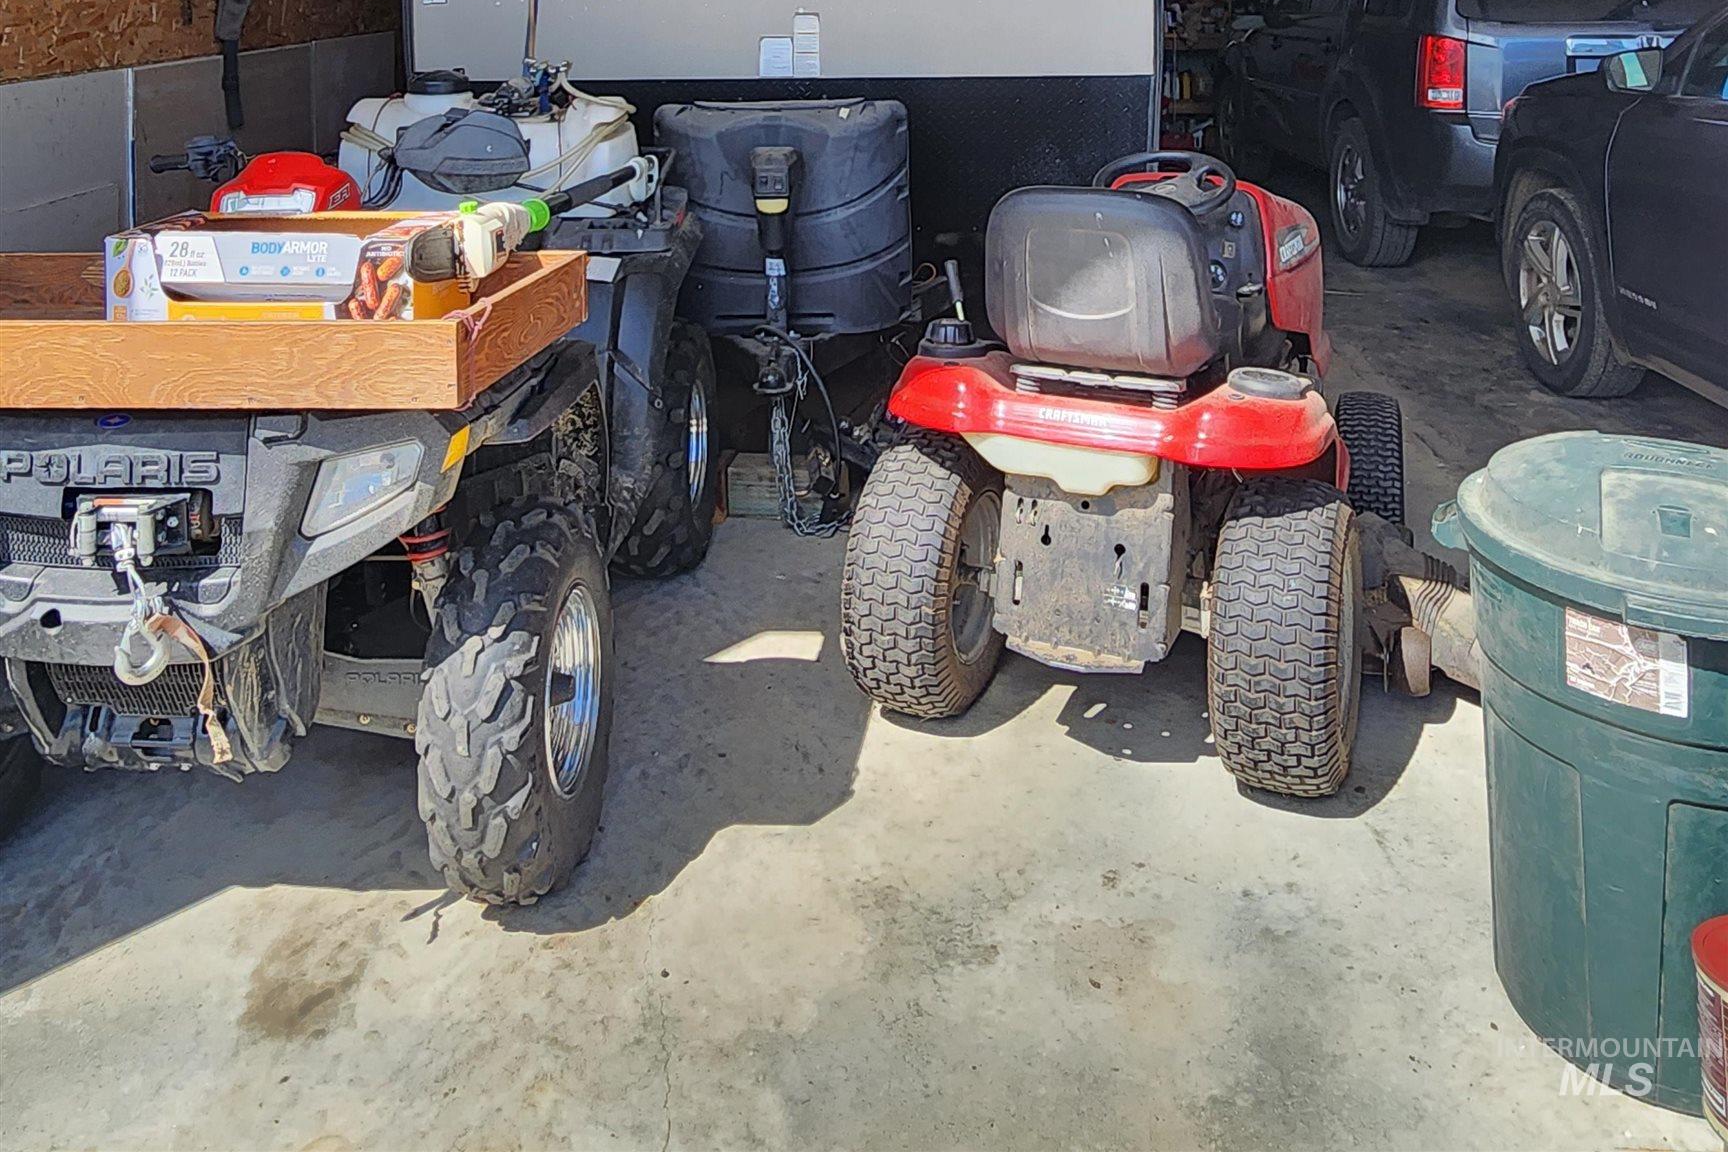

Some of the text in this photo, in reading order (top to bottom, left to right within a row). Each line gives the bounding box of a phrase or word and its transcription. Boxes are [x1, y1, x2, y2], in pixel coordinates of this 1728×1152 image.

[169, 241, 189, 258] 28
[251, 241, 328, 254] BODYARMOR
[306, 254, 327, 262] LYTE
[170, 268, 198, 277] 12 PACK
[1, 451, 220, 485] POLARIS
[345, 671, 424, 684] POLARI
